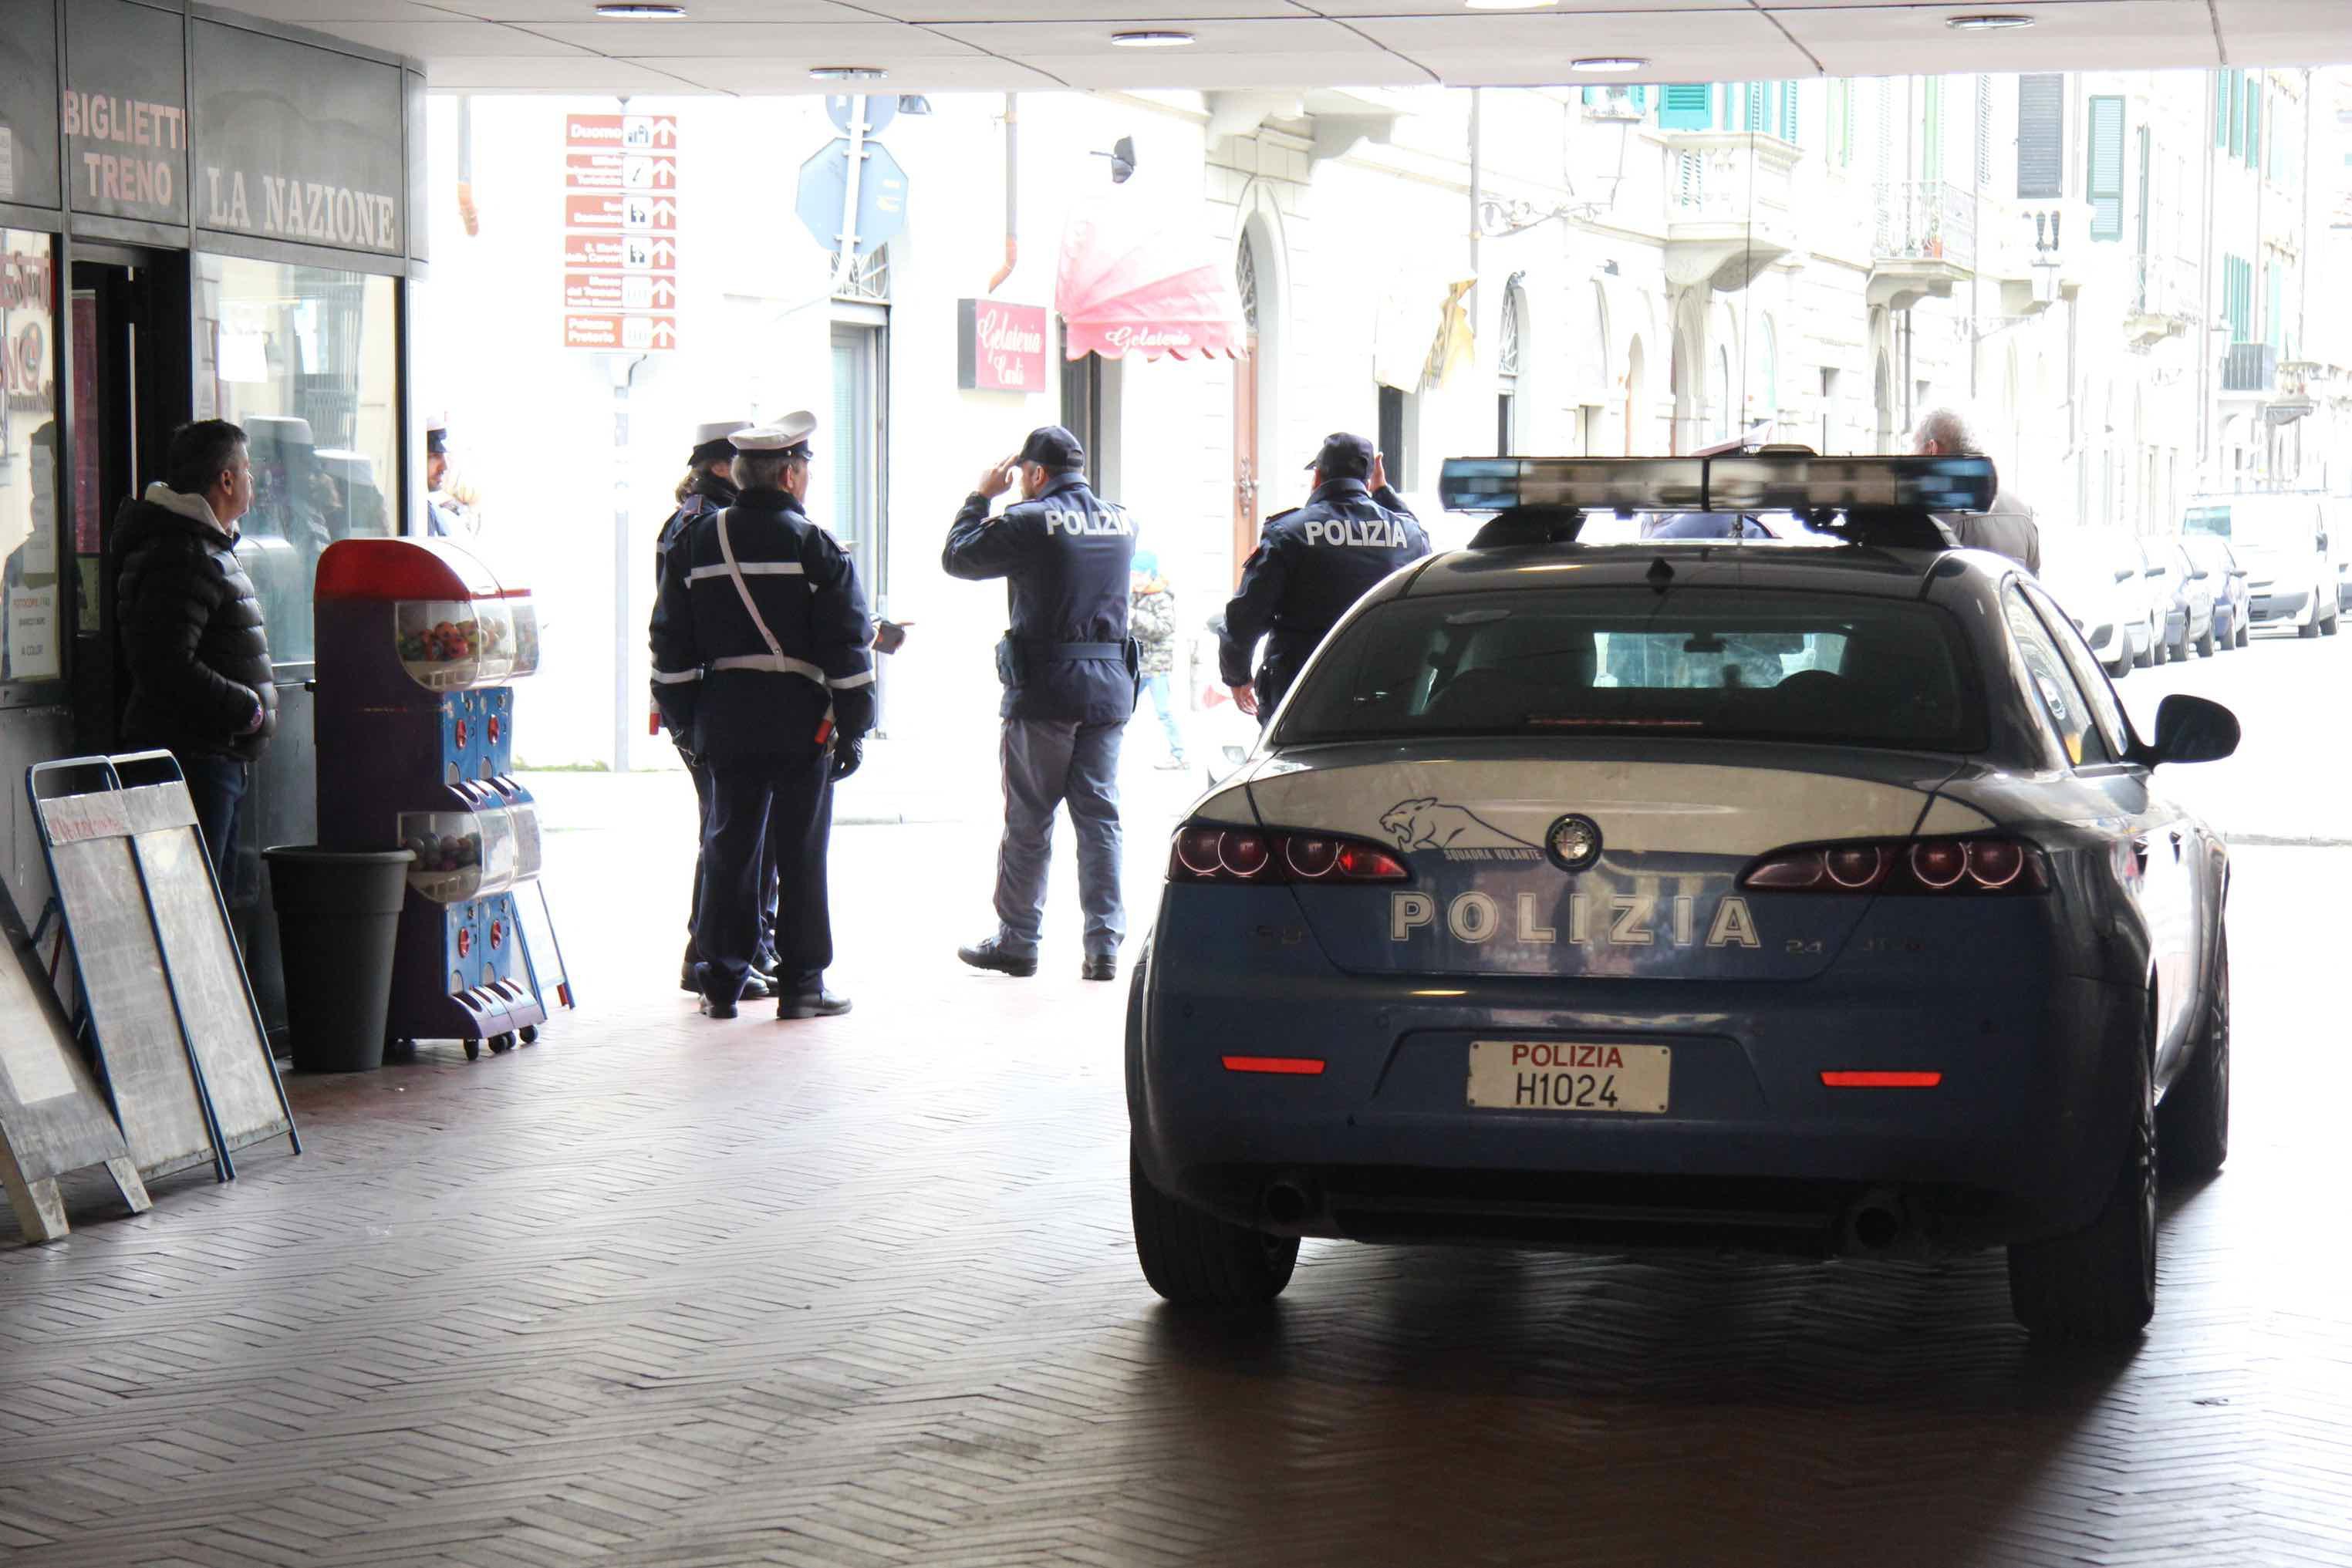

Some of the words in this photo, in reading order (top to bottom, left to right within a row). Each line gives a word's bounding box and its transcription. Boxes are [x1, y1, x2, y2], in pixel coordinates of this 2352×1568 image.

[64, 89, 187, 150] BIGLIETTI
[571, 123, 623, 139] Duomo
[83, 152, 173, 206] TRENO
[207, 167, 251, 228] LA
[263, 175, 395, 248] NAZIONE
[977, 308, 1041, 365] Gelateria
[1105, 325, 1192, 352] Gelateria
[1044, 510, 1134, 537] POLIZIA
[1304, 519, 1408, 548] POLIZIA
[1443, 848, 1493, 861] SQUADRA
[1493, 848, 1544, 861] VOLANTE
[1390, 890, 1762, 949] POLIZIA
[1511, 1044, 1624, 1068] POLIZIA
[1515, 1073, 1618, 1108] H1024
